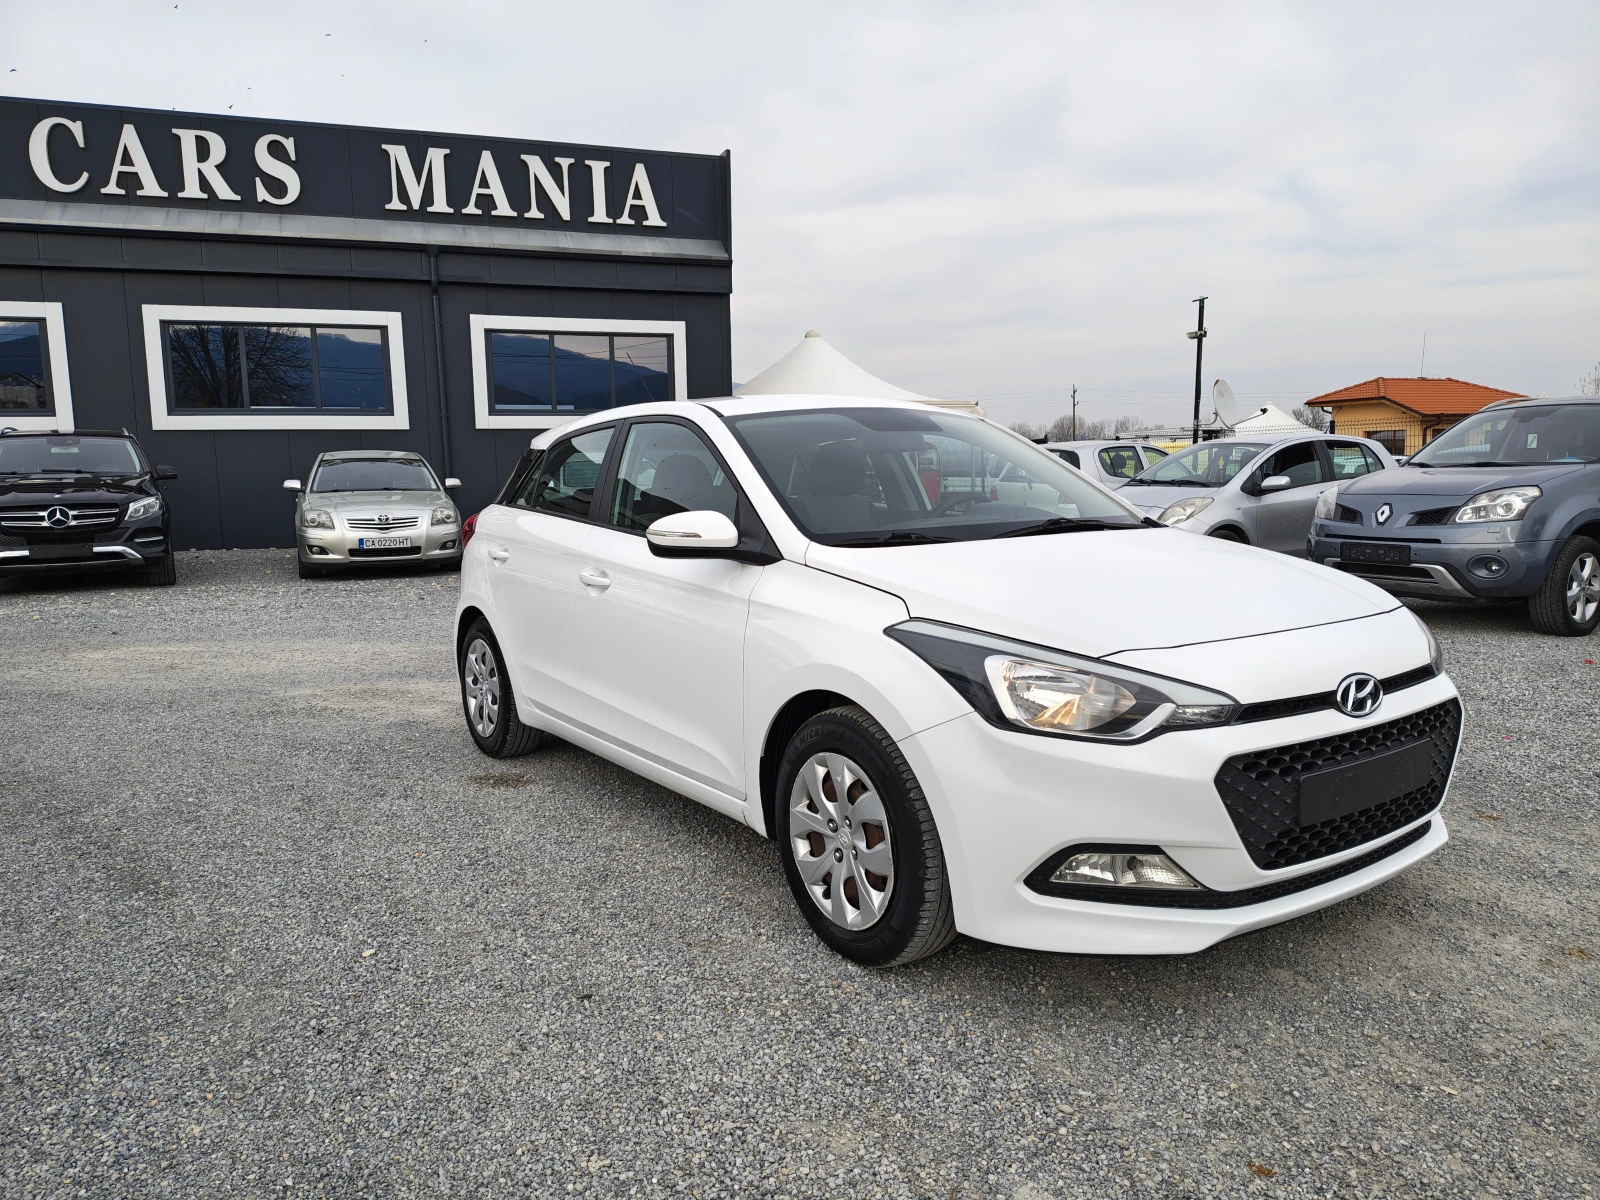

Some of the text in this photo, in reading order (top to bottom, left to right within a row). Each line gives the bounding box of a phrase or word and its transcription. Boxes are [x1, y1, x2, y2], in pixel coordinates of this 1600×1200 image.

[29, 116, 668, 228] CARS MANIA
[364, 538, 409, 547] CA 0220 HT
